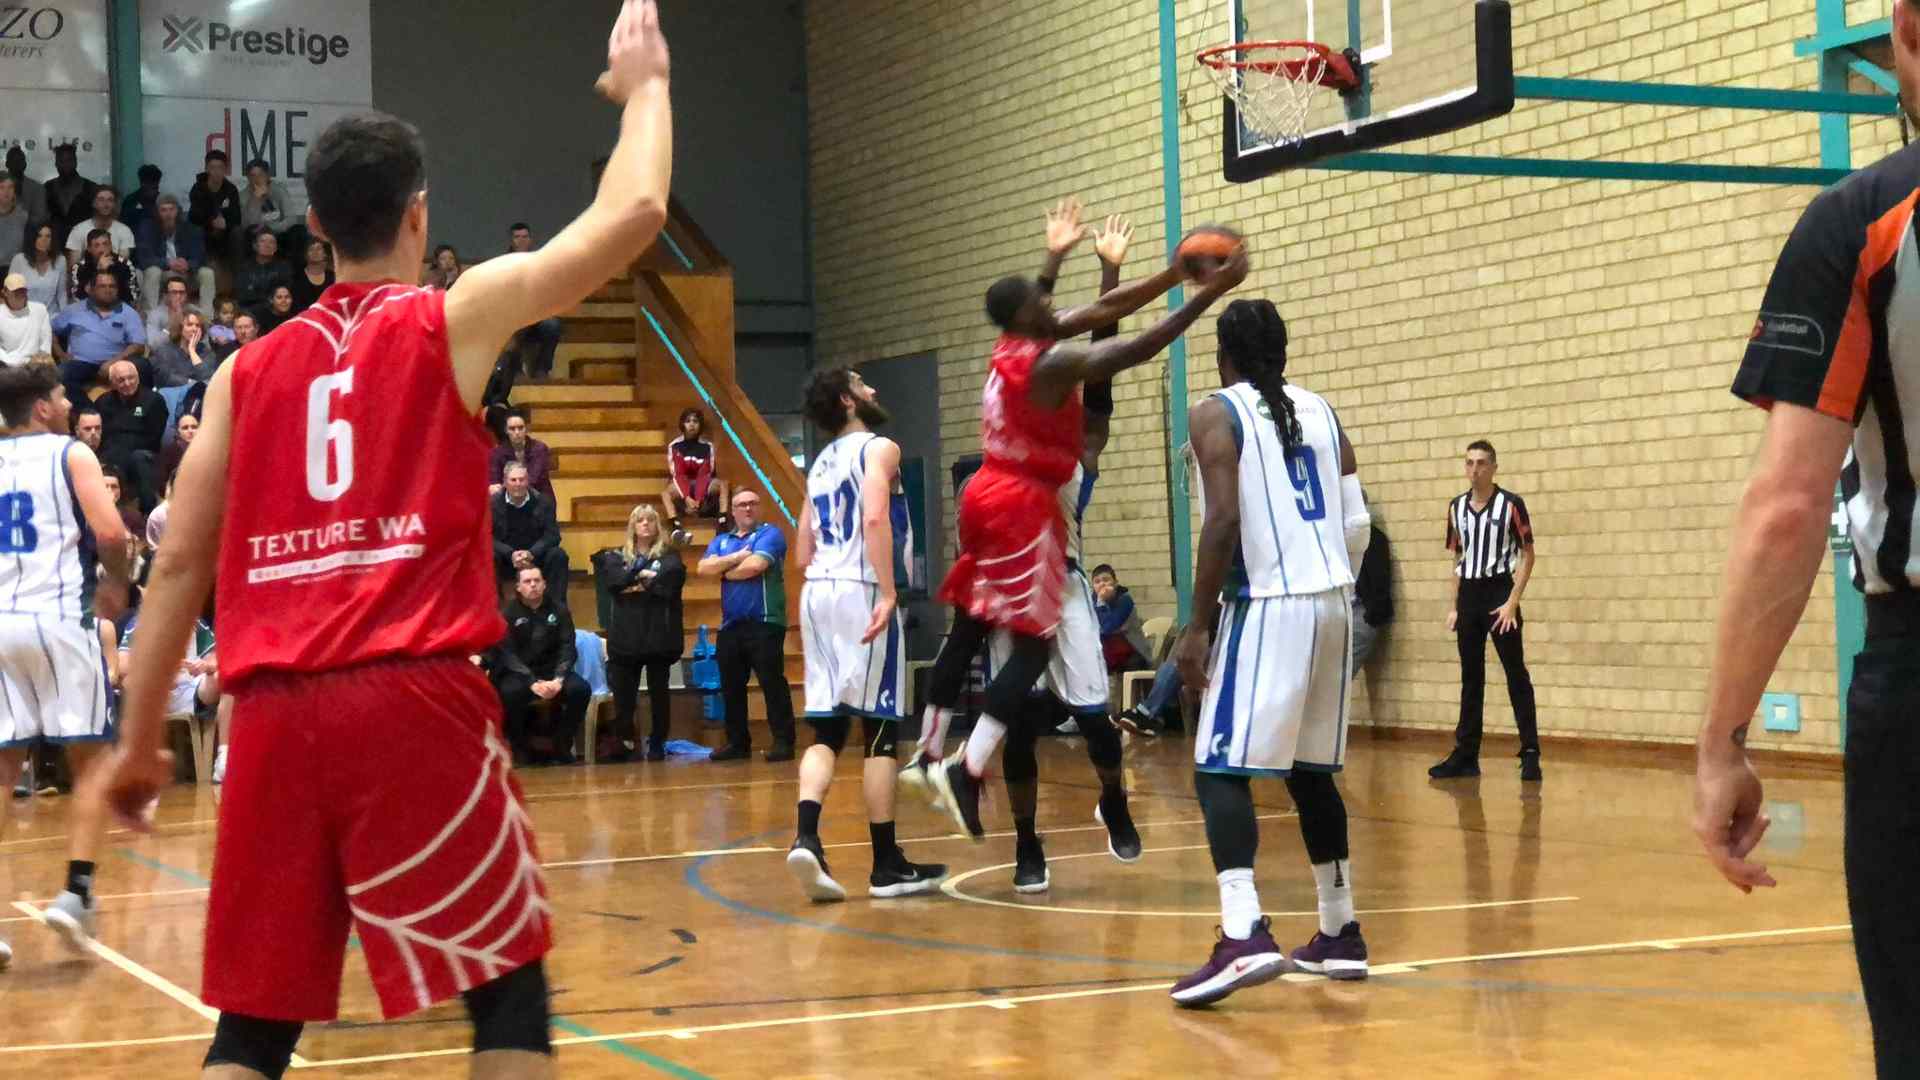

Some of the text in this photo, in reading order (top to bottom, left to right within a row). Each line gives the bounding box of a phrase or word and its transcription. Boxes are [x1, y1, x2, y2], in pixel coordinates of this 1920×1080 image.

[208, 22, 350, 65] Prestige
[306, 365, 354, 502] 6
[1283, 444, 1326, 521] 9
[248, 512, 427, 560] TEXTURE WA
